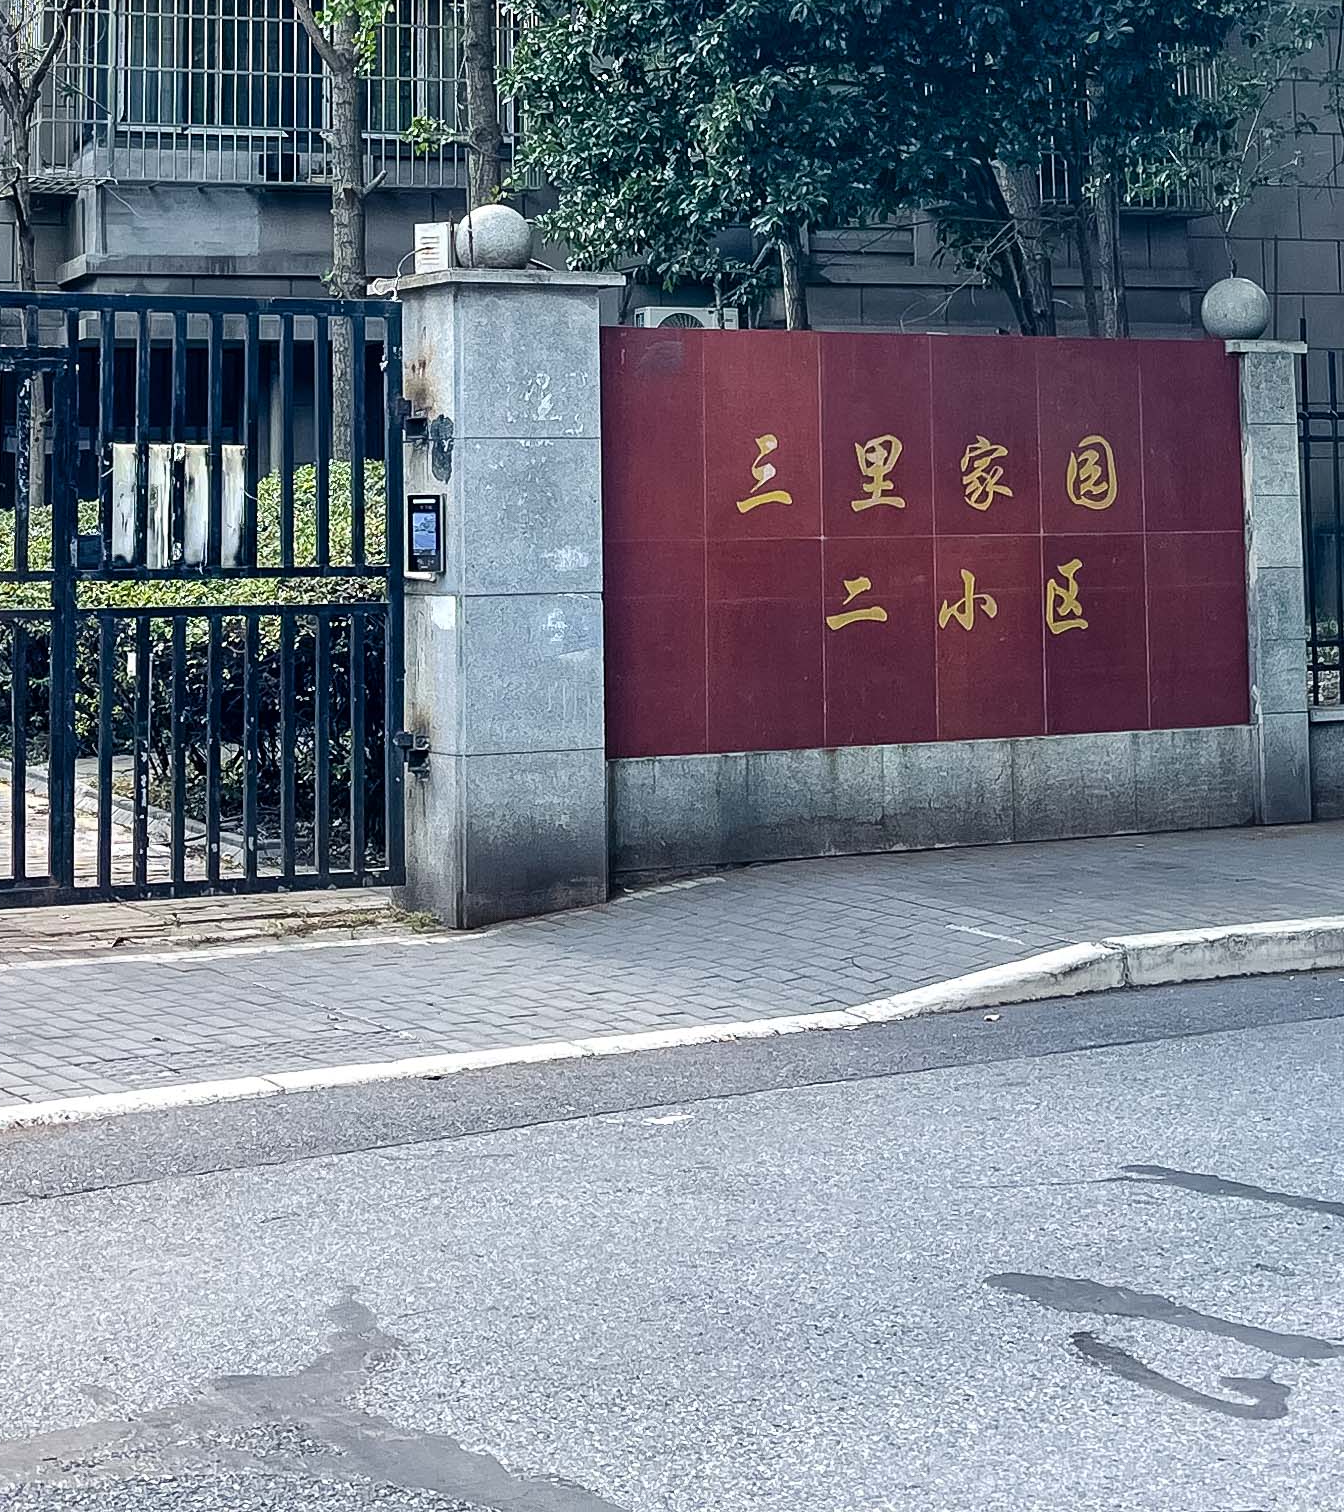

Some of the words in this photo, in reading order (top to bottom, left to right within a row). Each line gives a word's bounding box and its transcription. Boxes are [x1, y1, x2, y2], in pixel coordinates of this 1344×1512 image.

[737, 433, 1119, 514] 三里家园
[826, 558, 1089, 635] 二小区
